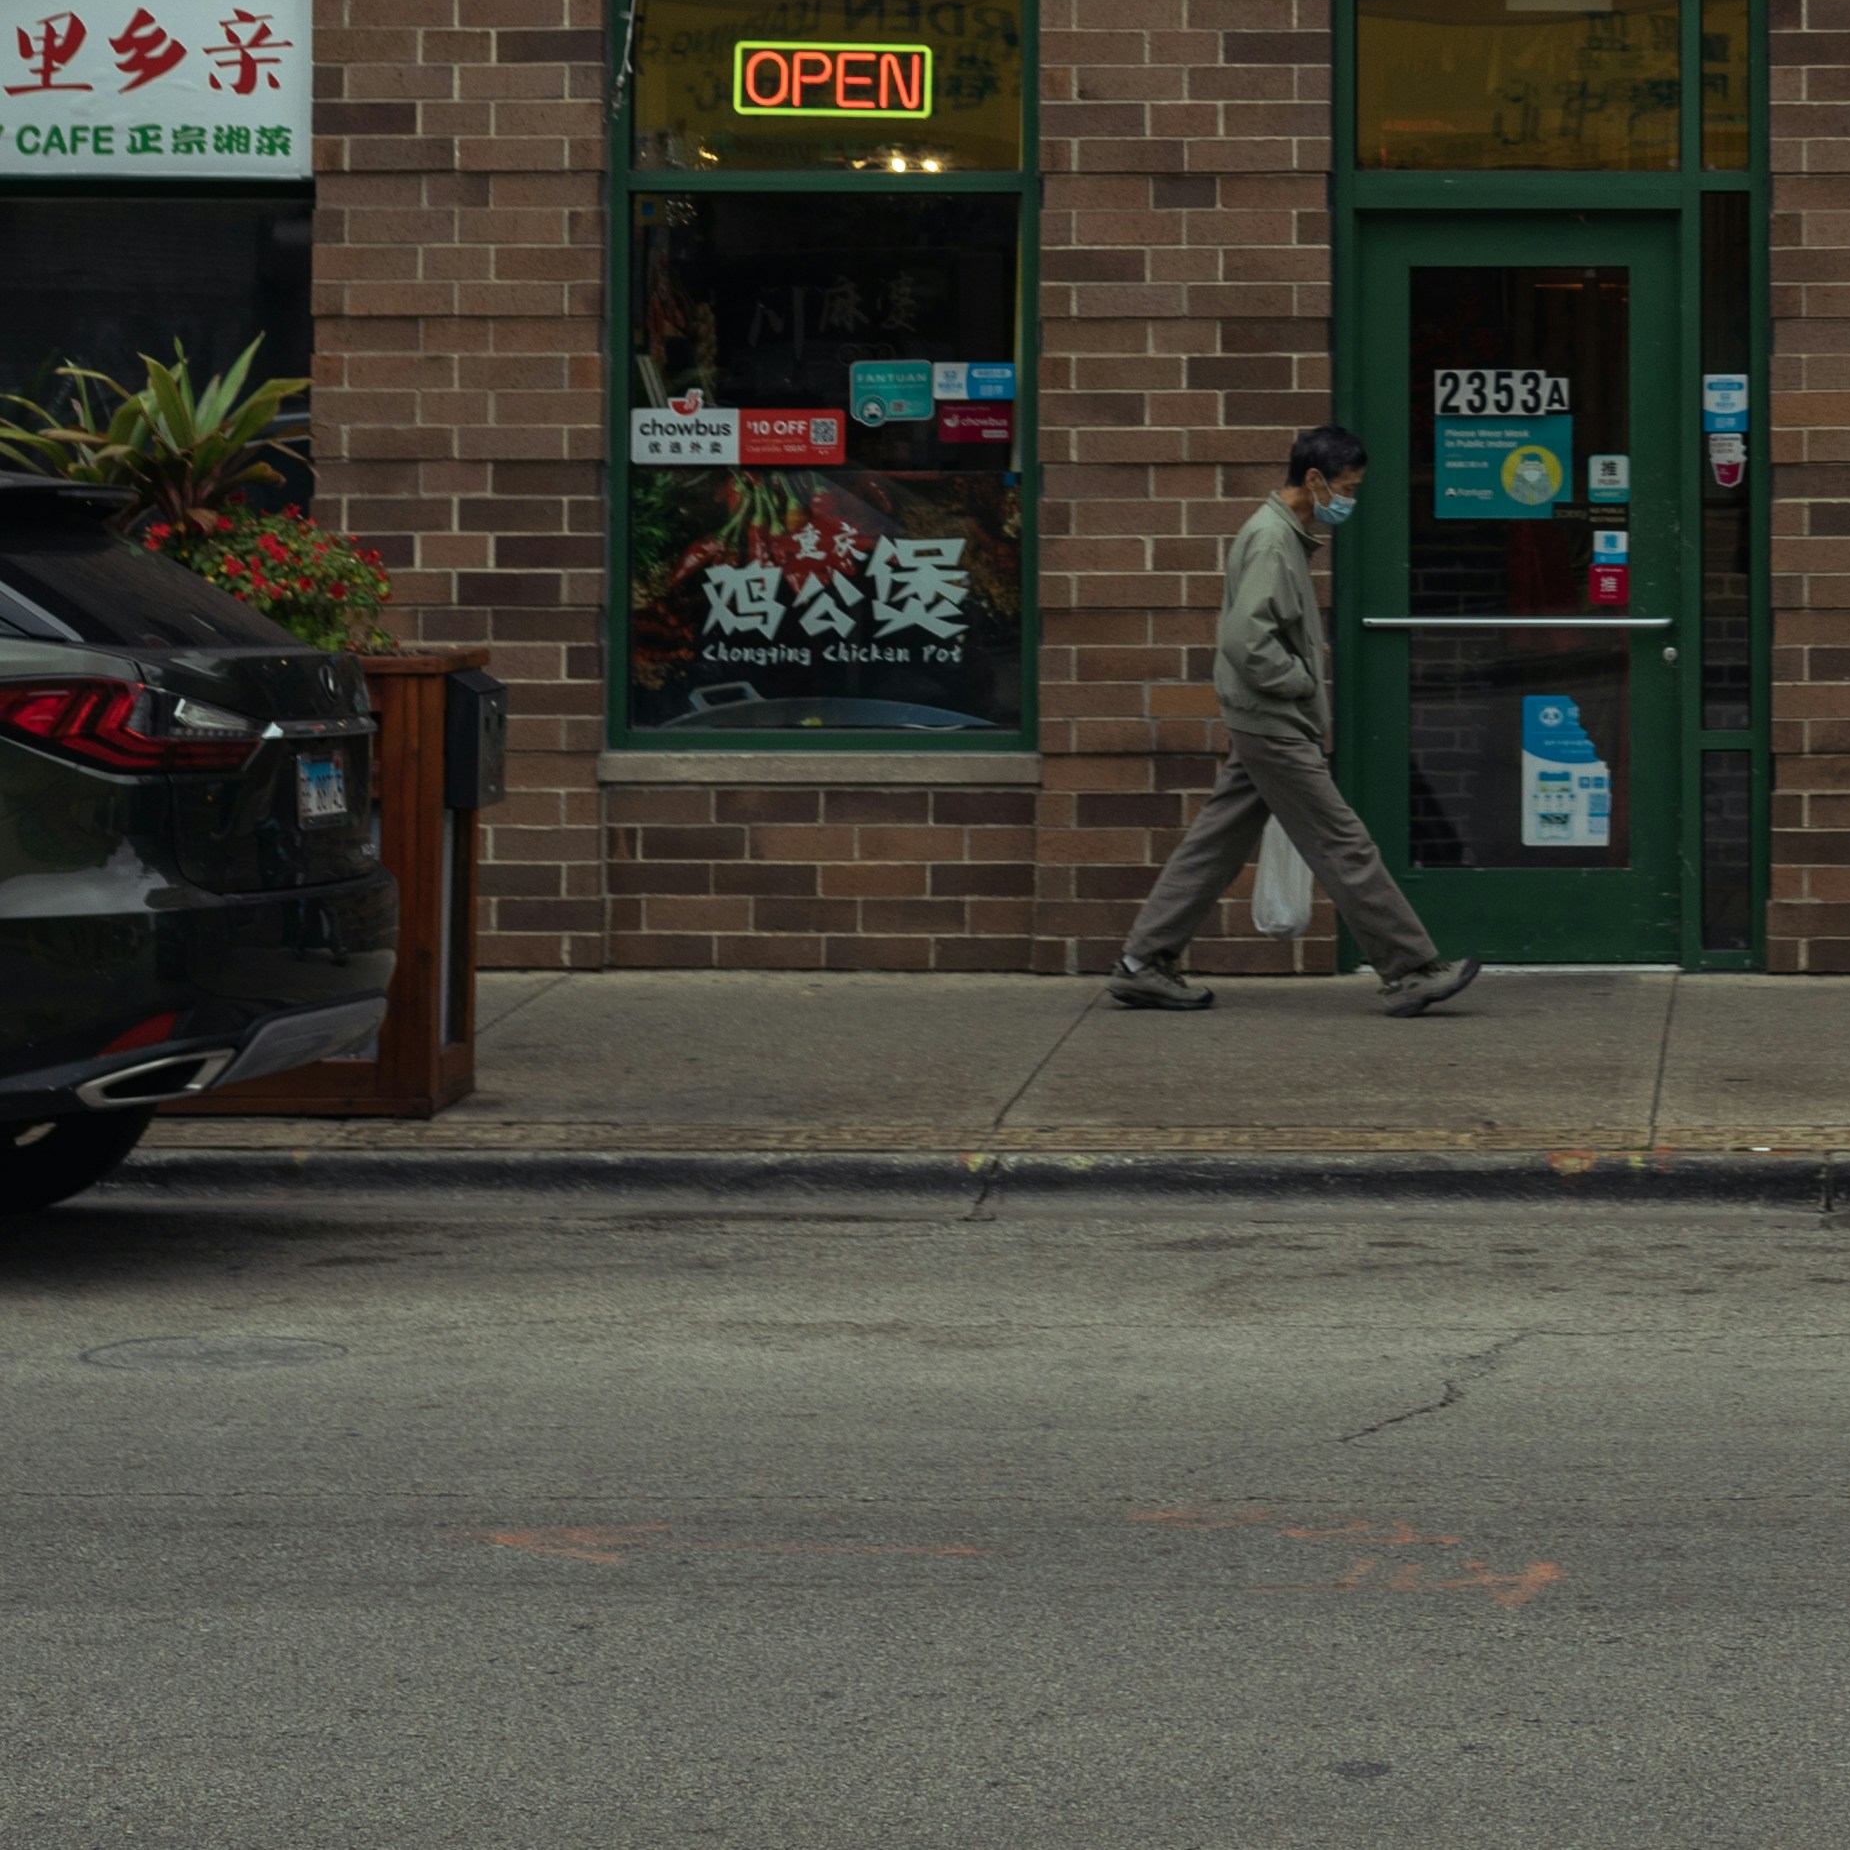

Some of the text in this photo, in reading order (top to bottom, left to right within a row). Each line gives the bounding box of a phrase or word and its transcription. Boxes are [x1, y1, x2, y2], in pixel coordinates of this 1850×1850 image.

[3, 7, 294, 96] 里乡亲
[745, 50, 921, 110] OPEN
[15, 124, 115, 156] CAFE
[125, 123, 293, 157] 正宗湘菜
[857, 373, 928, 383] FANTUAN
[639, 417, 732, 437] chowbus
[746, 420, 808, 436] $10 OFF
[792, 521, 868, 562] 重庆
[701, 534, 971, 641] 鸡公煲
[701, 640, 965, 666] Chongqing Chicken Pot
